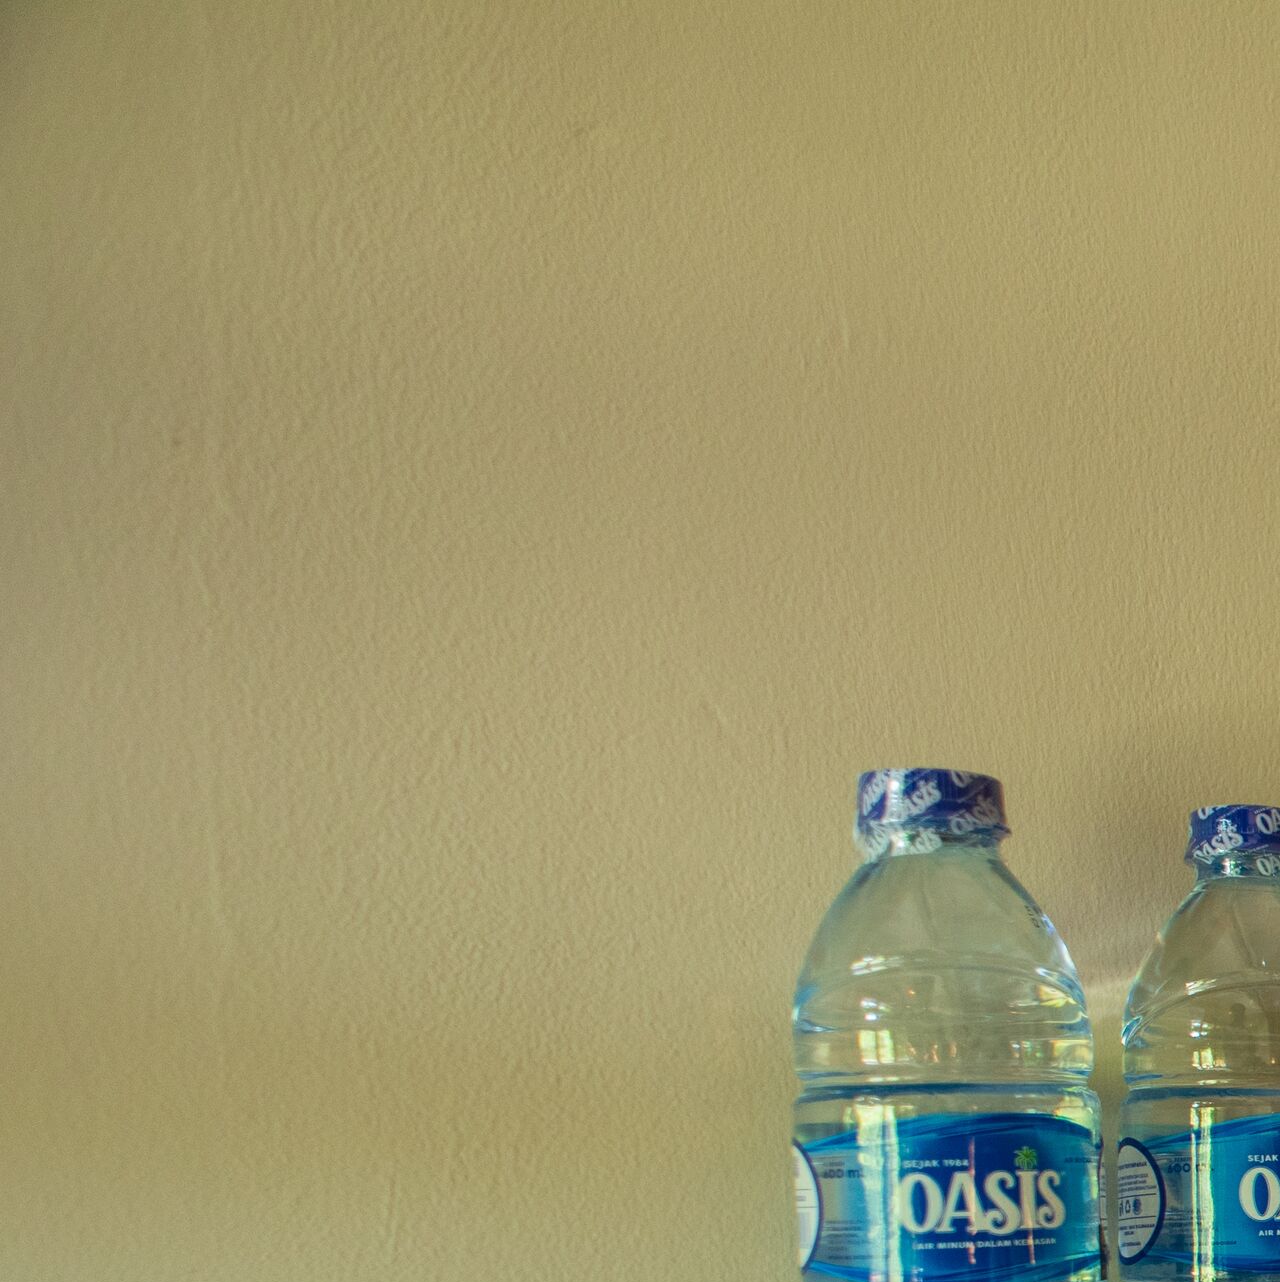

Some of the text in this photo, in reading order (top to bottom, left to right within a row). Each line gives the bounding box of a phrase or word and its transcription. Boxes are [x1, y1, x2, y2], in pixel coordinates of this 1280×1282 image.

[1247, 1154, 1278, 1163] SEJAK
[900, 1169, 1066, 1235] OASIS
[977, 1240, 1012, 1248] DALAM
